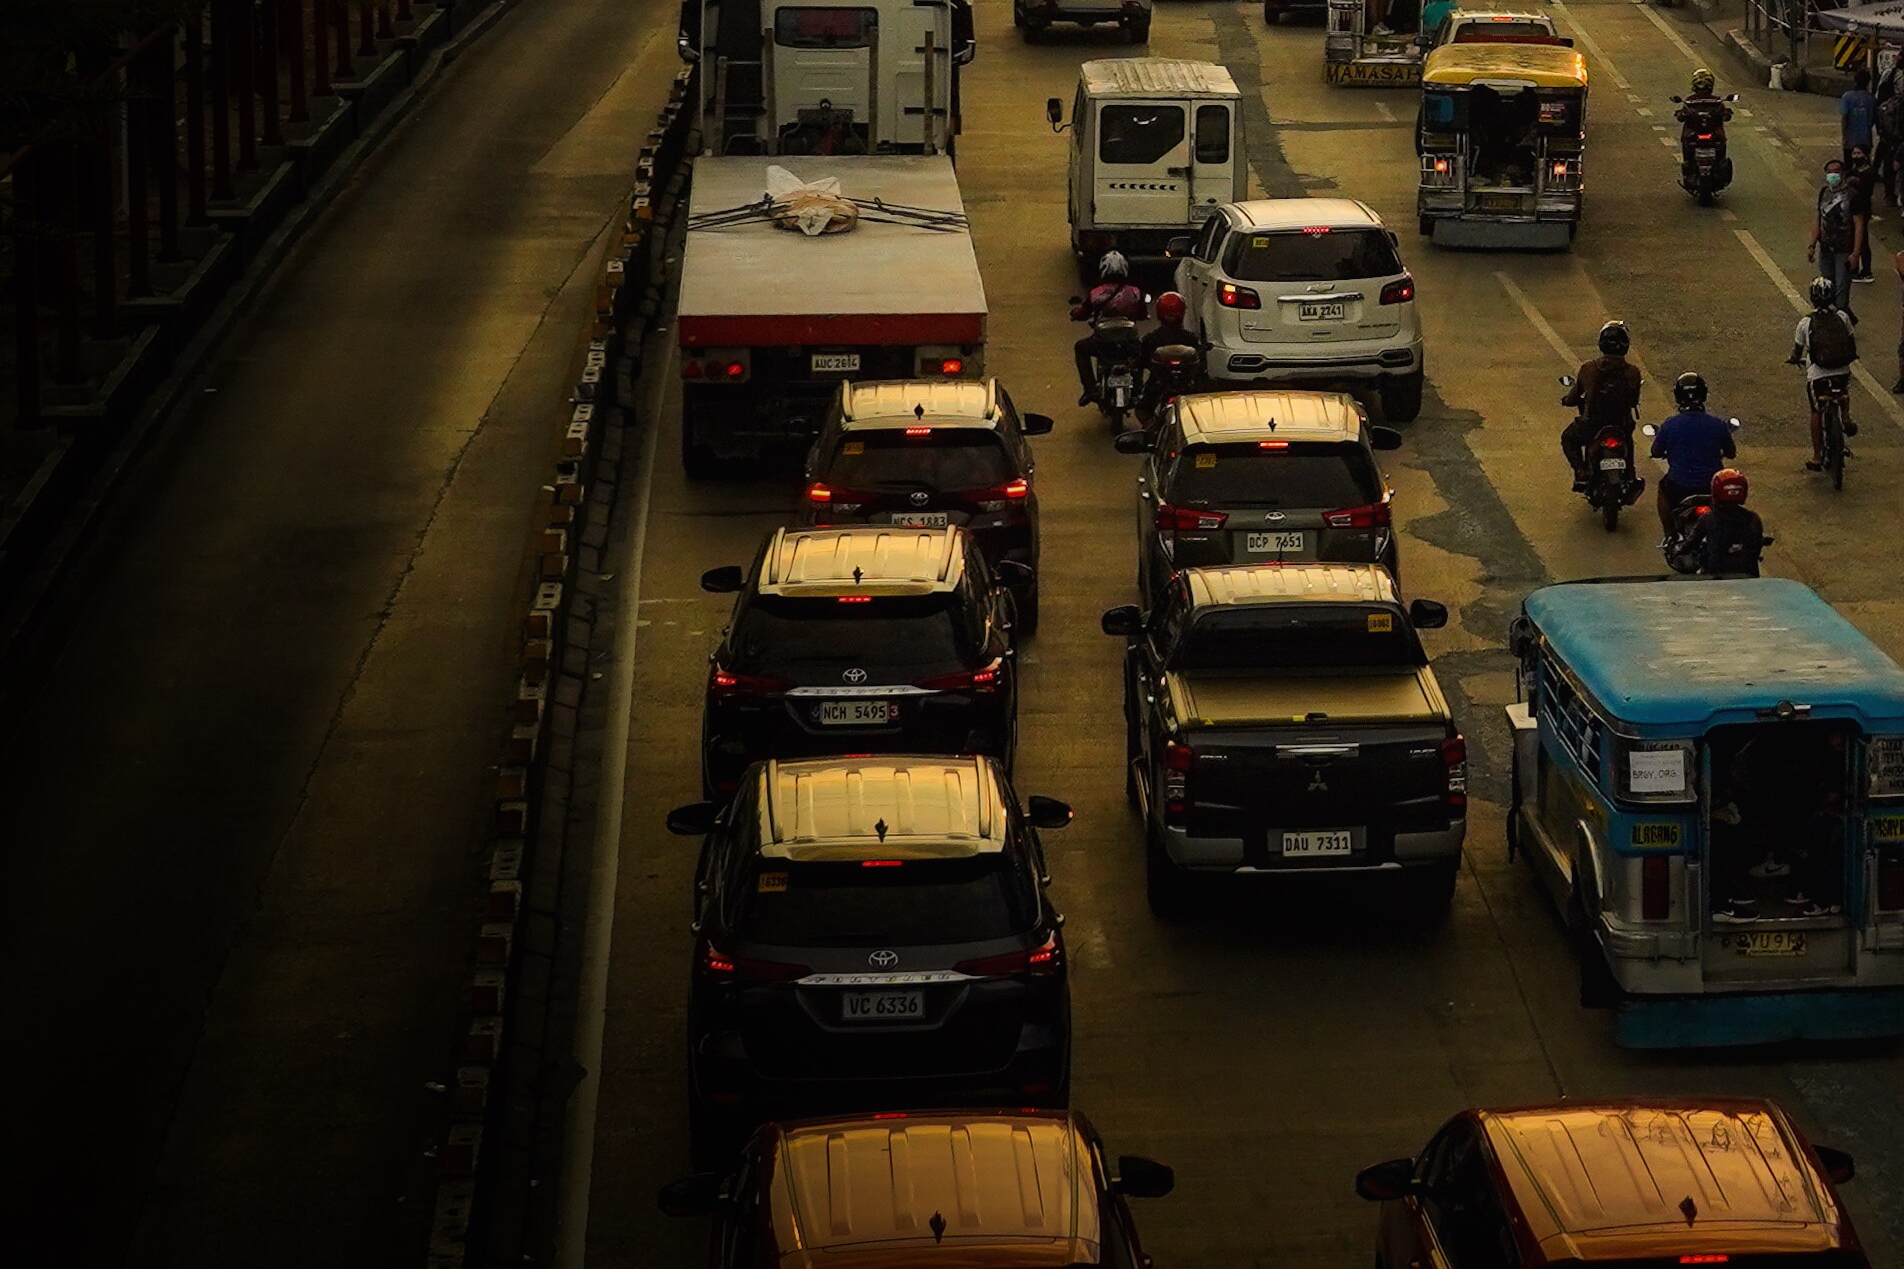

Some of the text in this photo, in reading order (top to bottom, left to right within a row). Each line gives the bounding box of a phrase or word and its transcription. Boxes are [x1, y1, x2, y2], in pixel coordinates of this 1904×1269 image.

[823, 704, 847, 720] NCH
[854, 703, 887, 720] 5495
[1285, 833, 1349, 852] DAU 7311
[850, 996, 918, 1015] VC 6336
